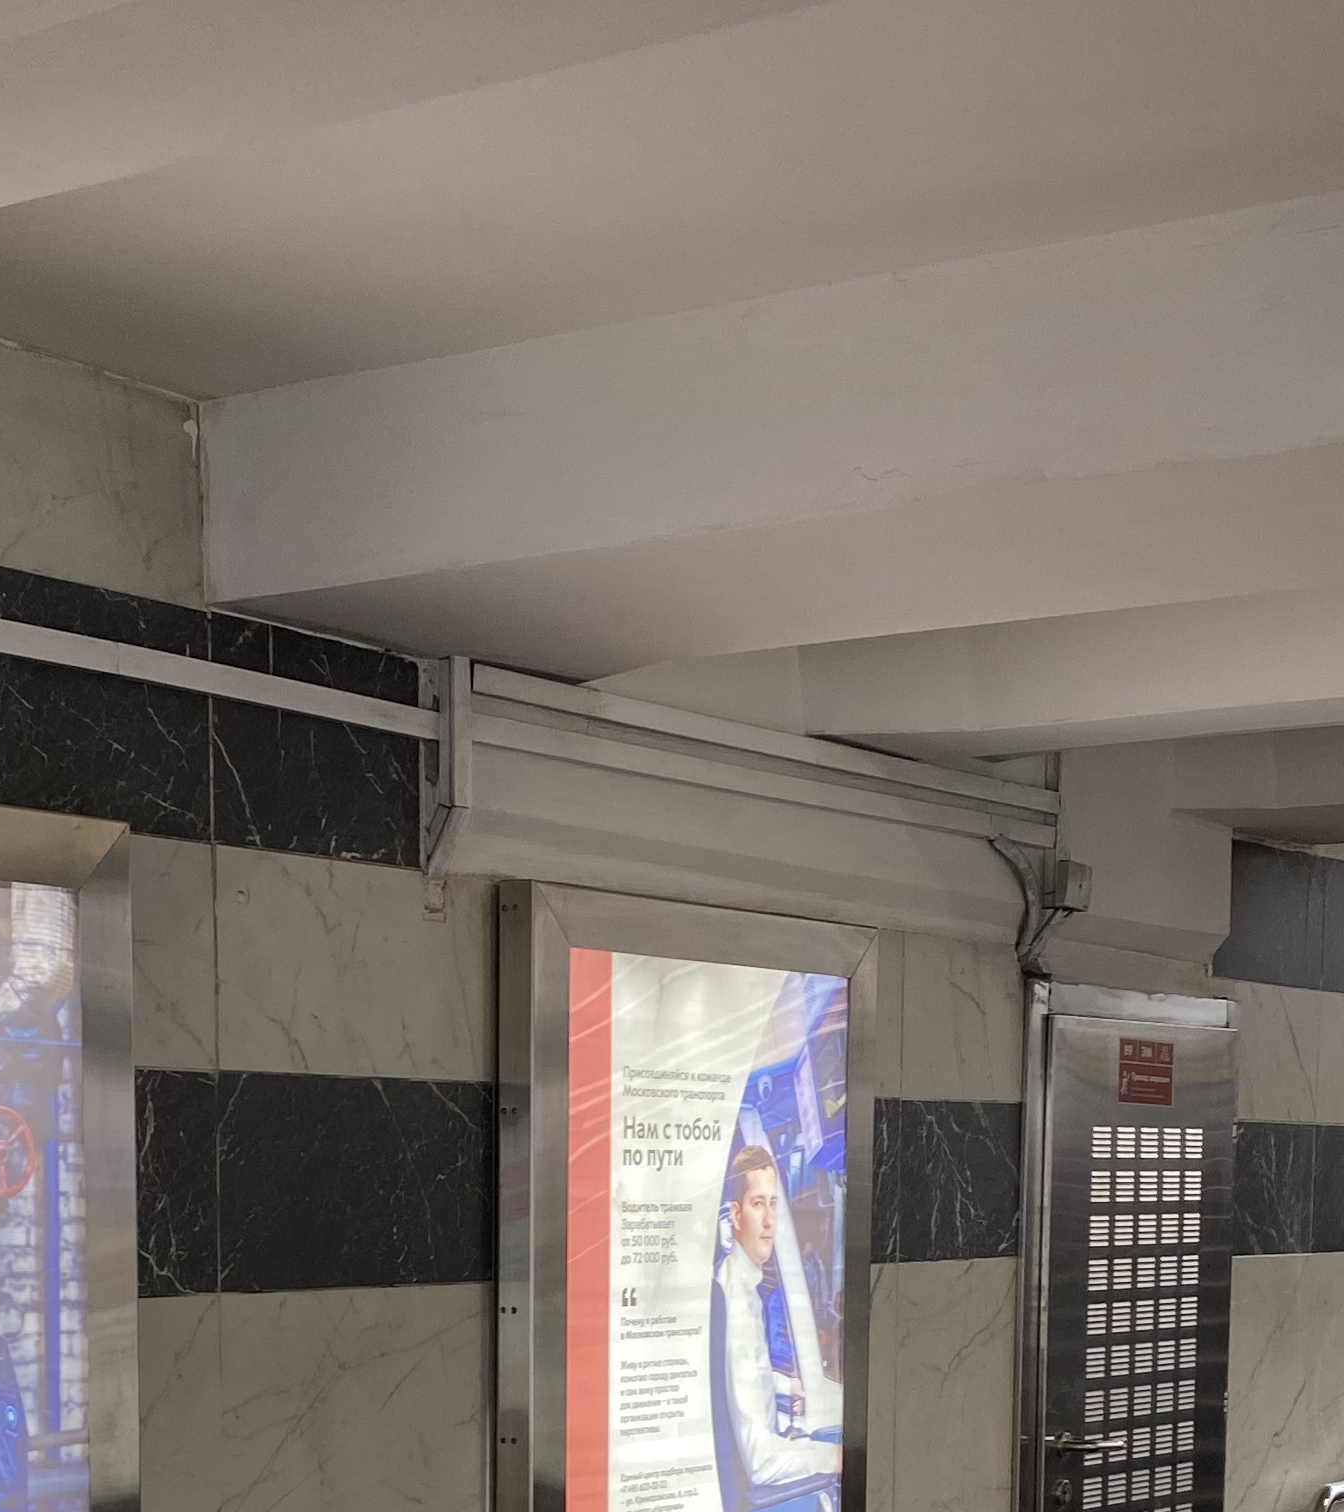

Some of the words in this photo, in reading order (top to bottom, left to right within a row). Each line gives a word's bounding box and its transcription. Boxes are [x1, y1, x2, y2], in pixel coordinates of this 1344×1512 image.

[623, 1084, 679, 1099] Московского
[623, 1116, 658, 1139] Нам
[663, 1123, 671, 1139] с
[676, 1118, 721, 1141] тобой
[623, 1149, 643, 1166] по
[647, 1149, 683, 1171] пути
